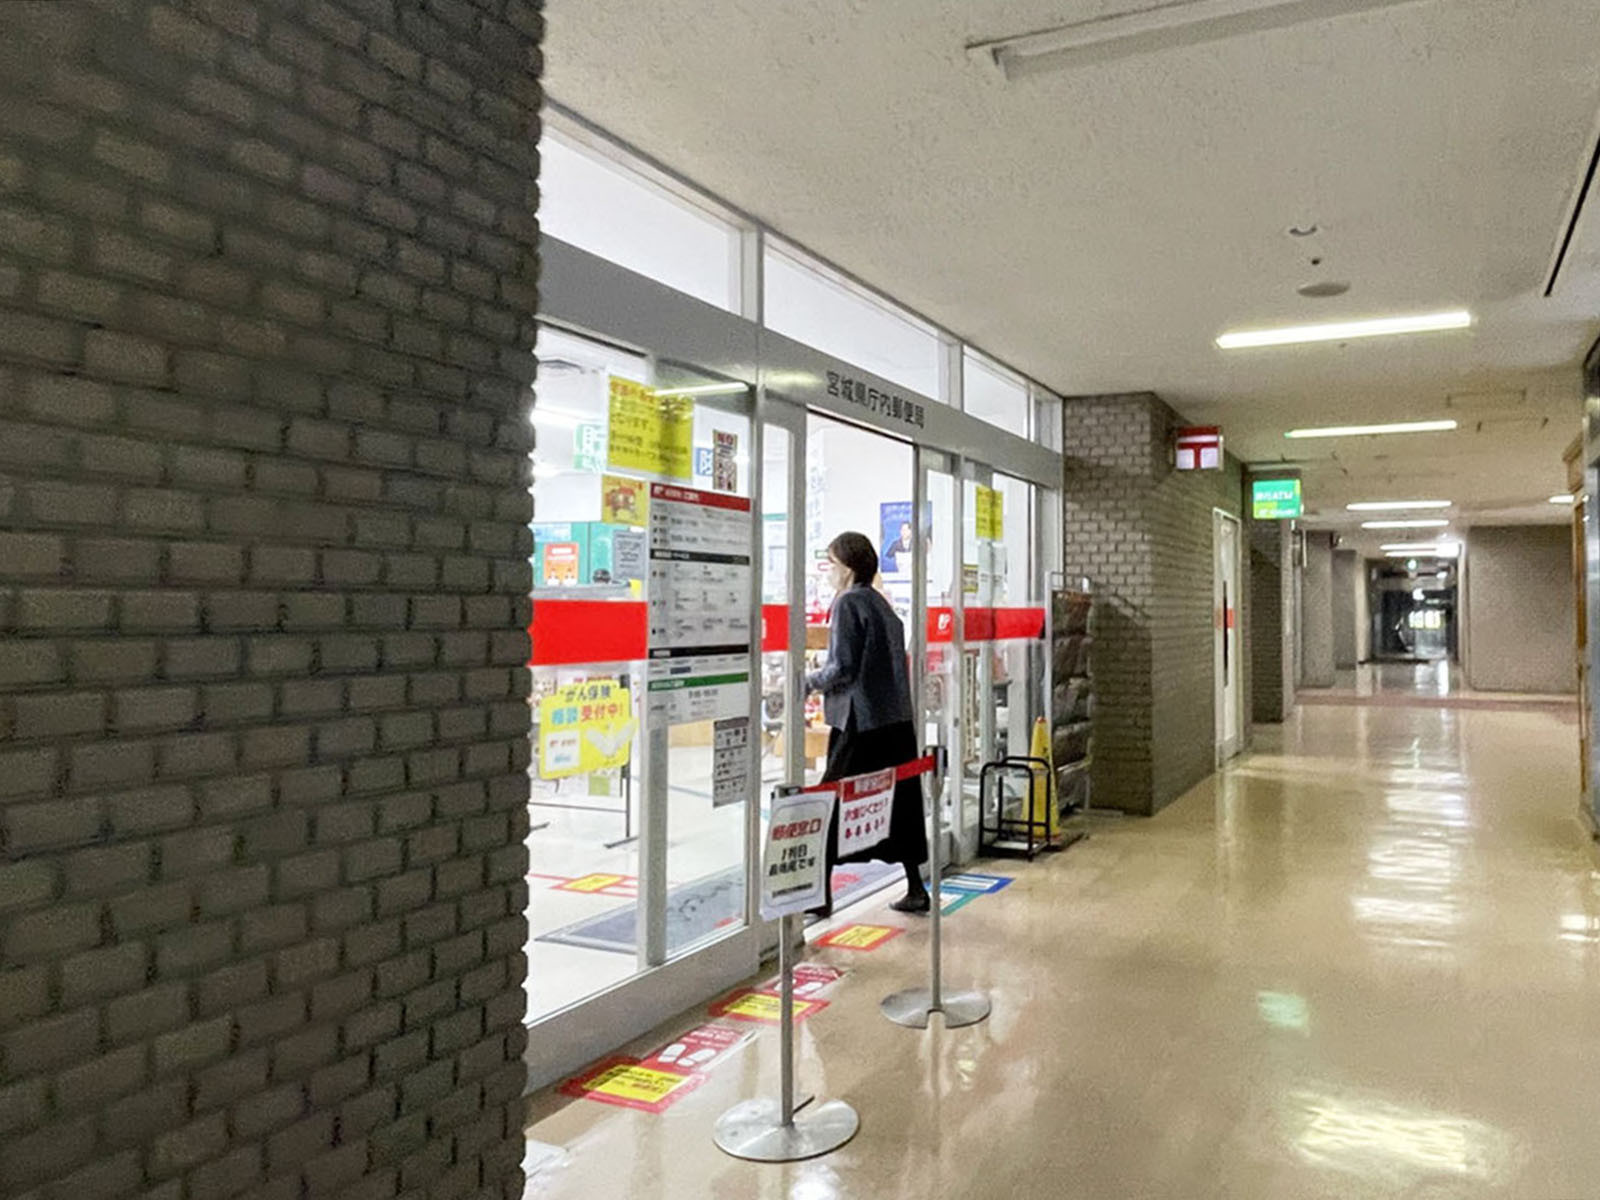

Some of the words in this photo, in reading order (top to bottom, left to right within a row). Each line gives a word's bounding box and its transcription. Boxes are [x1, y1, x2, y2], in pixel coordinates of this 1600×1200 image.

[827, 370, 925, 429] 宮城県庁内郵便局
[771, 818, 822, 841] 郵便窓口
